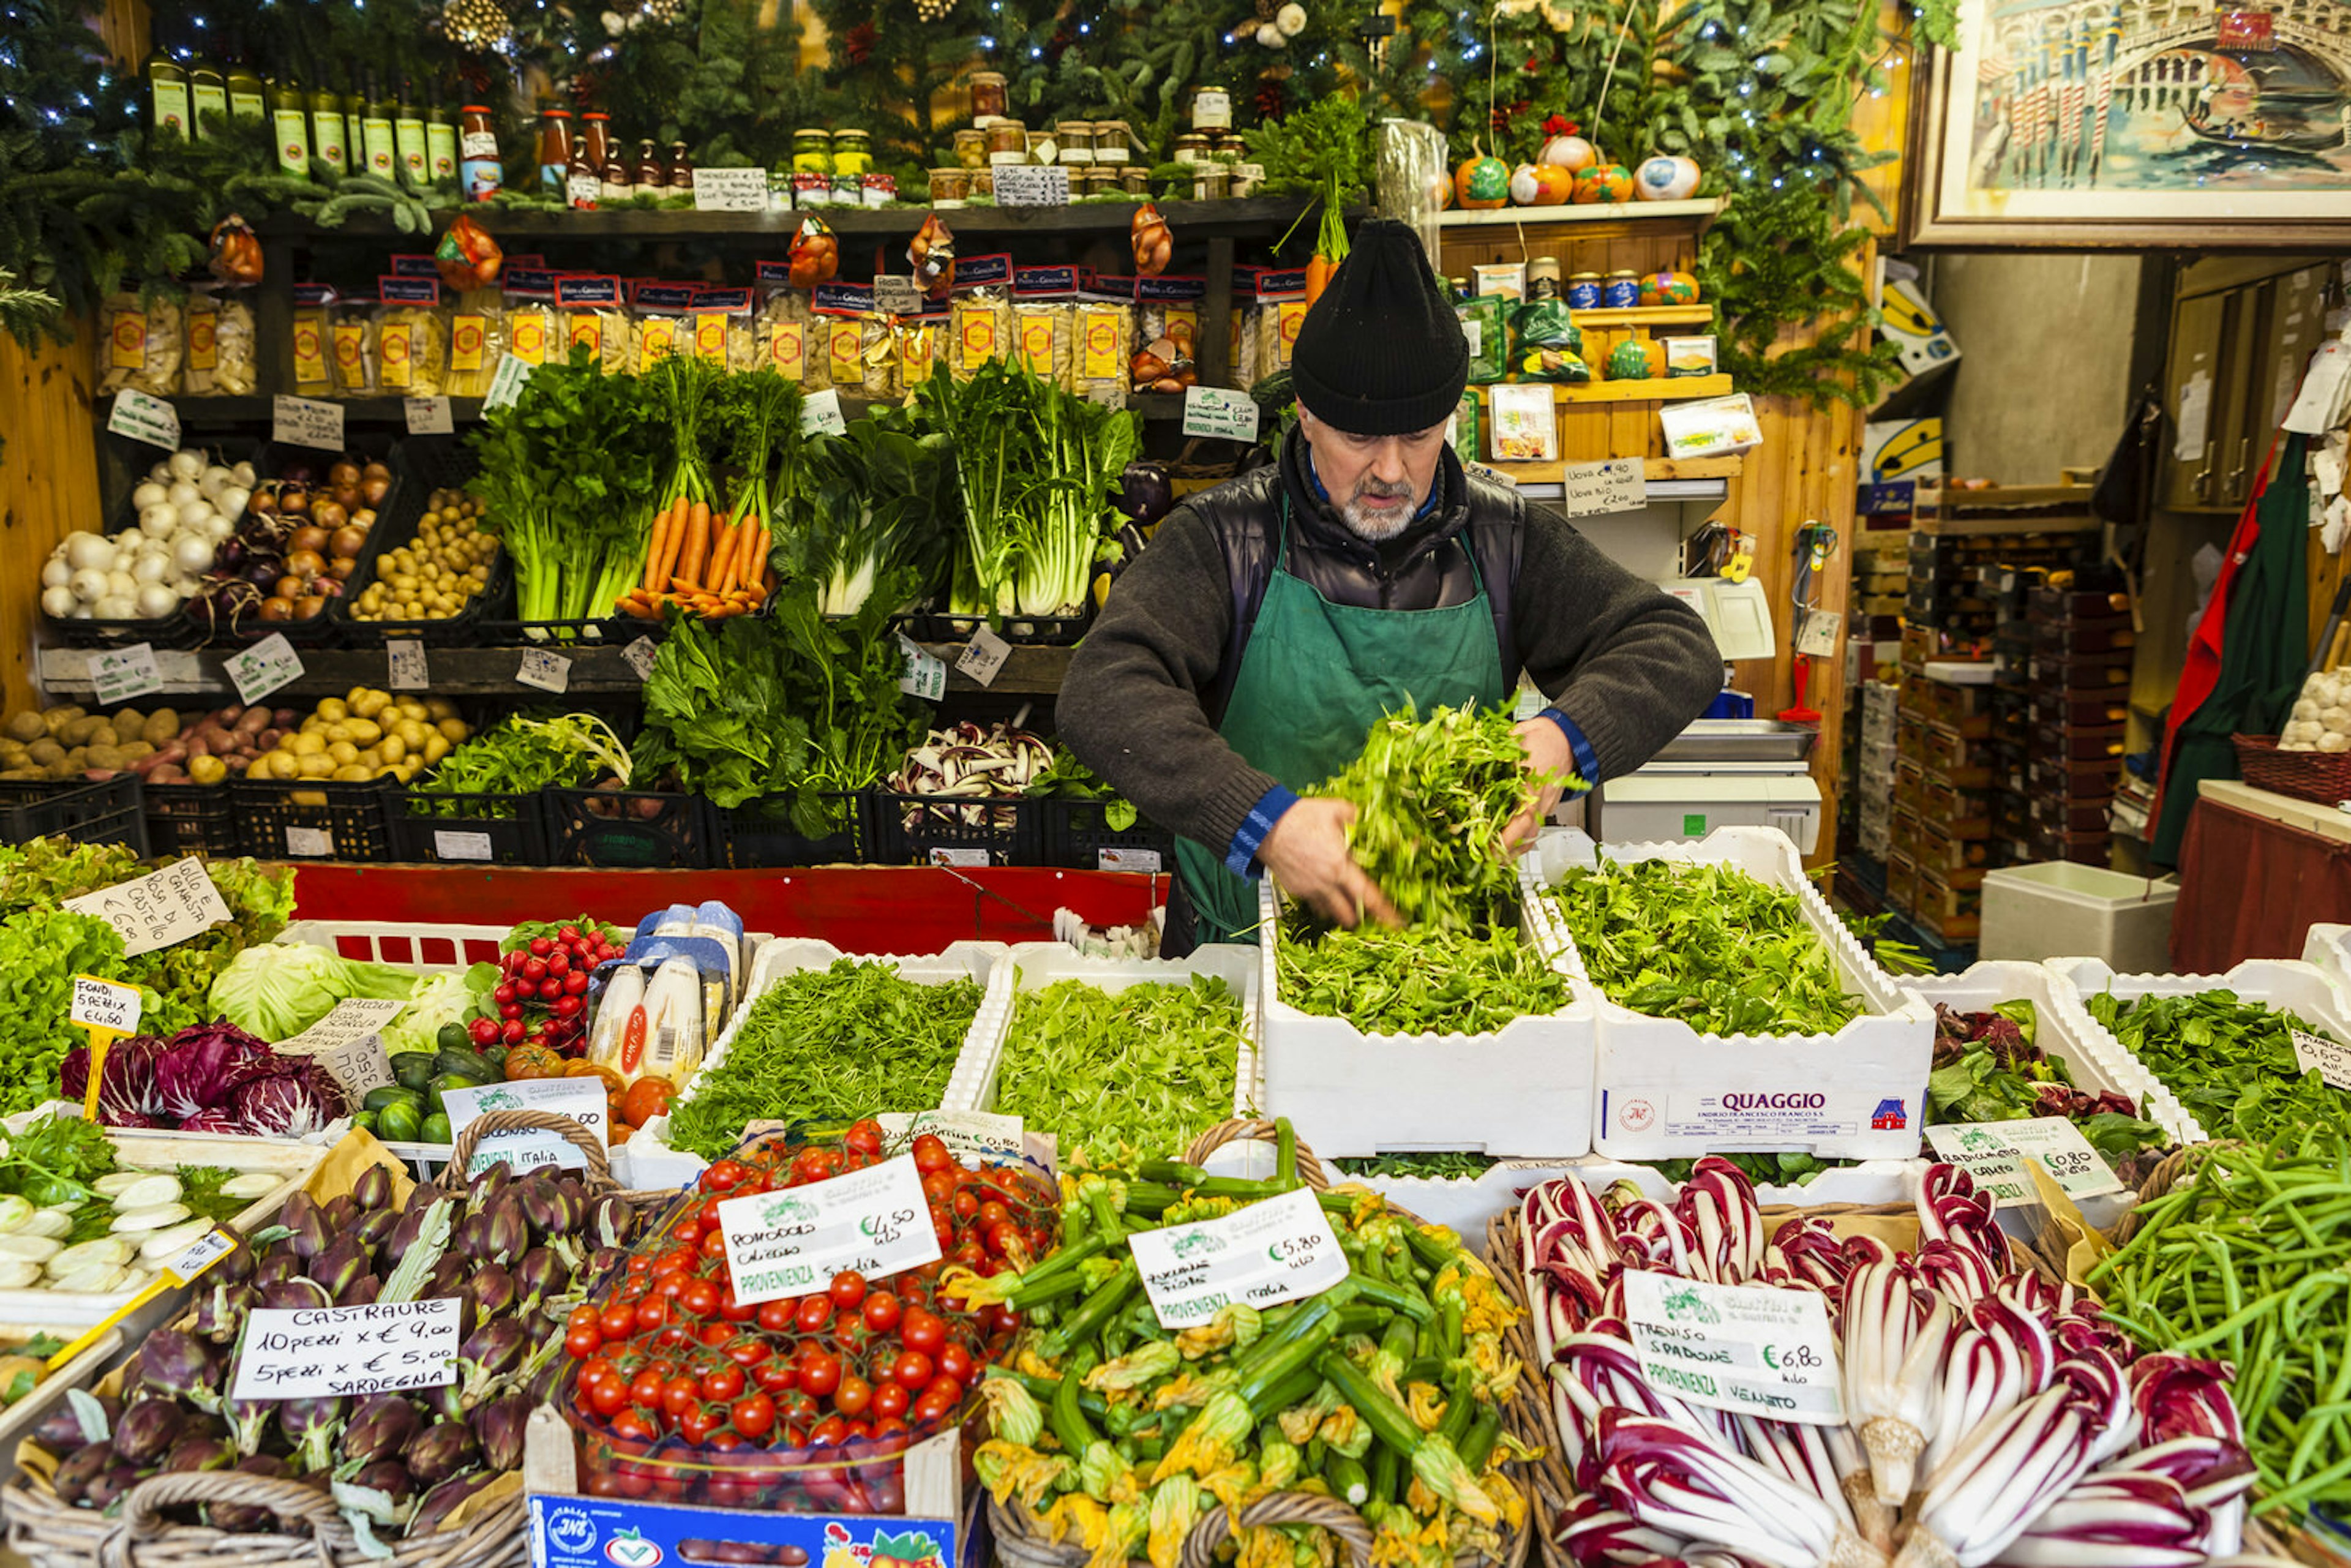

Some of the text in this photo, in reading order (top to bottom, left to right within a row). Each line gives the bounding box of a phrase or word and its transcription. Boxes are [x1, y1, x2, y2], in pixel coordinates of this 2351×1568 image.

[144, 873, 167, 904] ROSA
[169, 874, 206, 923] CANASTA
[1722, 1093, 1826, 1111] QUAGGIO
[739, 1264, 816, 1295] PROVENIENZA
[293, 1300, 446, 1327] CASTRAURE
[1160, 1291, 1232, 1319] PROVENIENZA
[376, 1322, 401, 1344] €
[409, 1320, 454, 1340] 9,00
[1632, 1321, 1706, 1341] TREVISO
[362, 1352, 391, 1372] €
[401, 1349, 451, 1365] 5,00
[328, 1371, 443, 1394] SARDEGNA
[1645, 1362, 1719, 1398] PROVENIENZA
